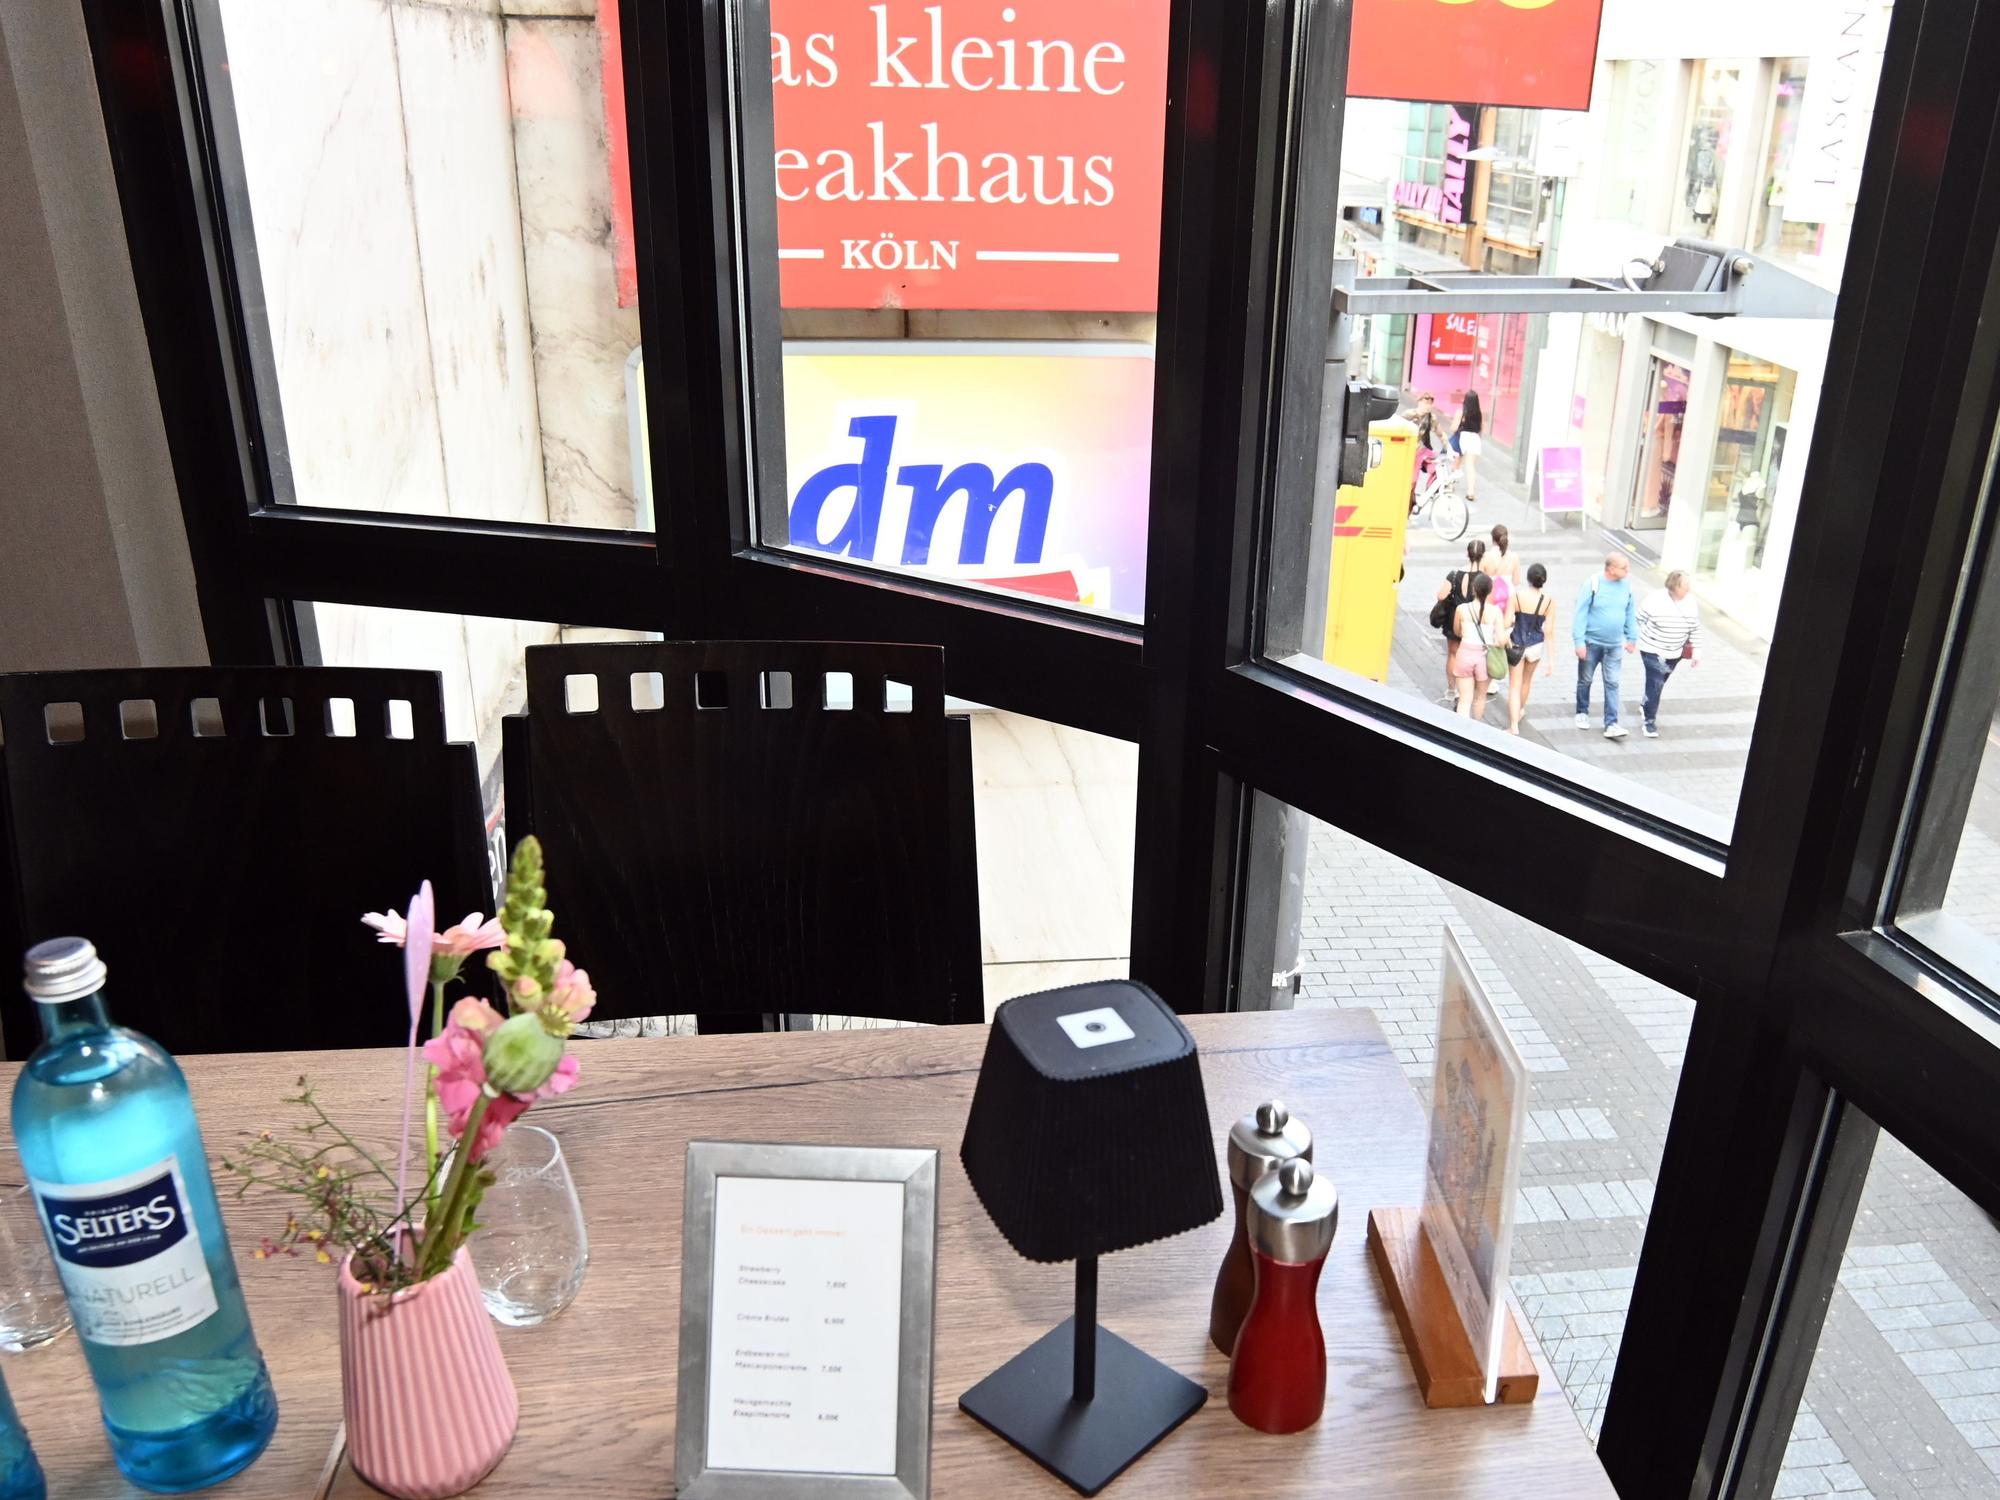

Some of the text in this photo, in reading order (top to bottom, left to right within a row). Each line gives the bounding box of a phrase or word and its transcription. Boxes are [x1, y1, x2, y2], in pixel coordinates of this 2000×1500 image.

[771, 4, 1125, 95] as kleine
[1813, 0, 1869, 186] LASCAN
[775, 122, 1115, 206] eakhaus
[1441, 103, 1471, 224] TALLY
[840, 232, 960, 271] KÖLN
[1445, 313, 1476, 337] SALE
[789, 415, 1053, 566] dm
[54, 1195, 176, 1246] SELTERS
